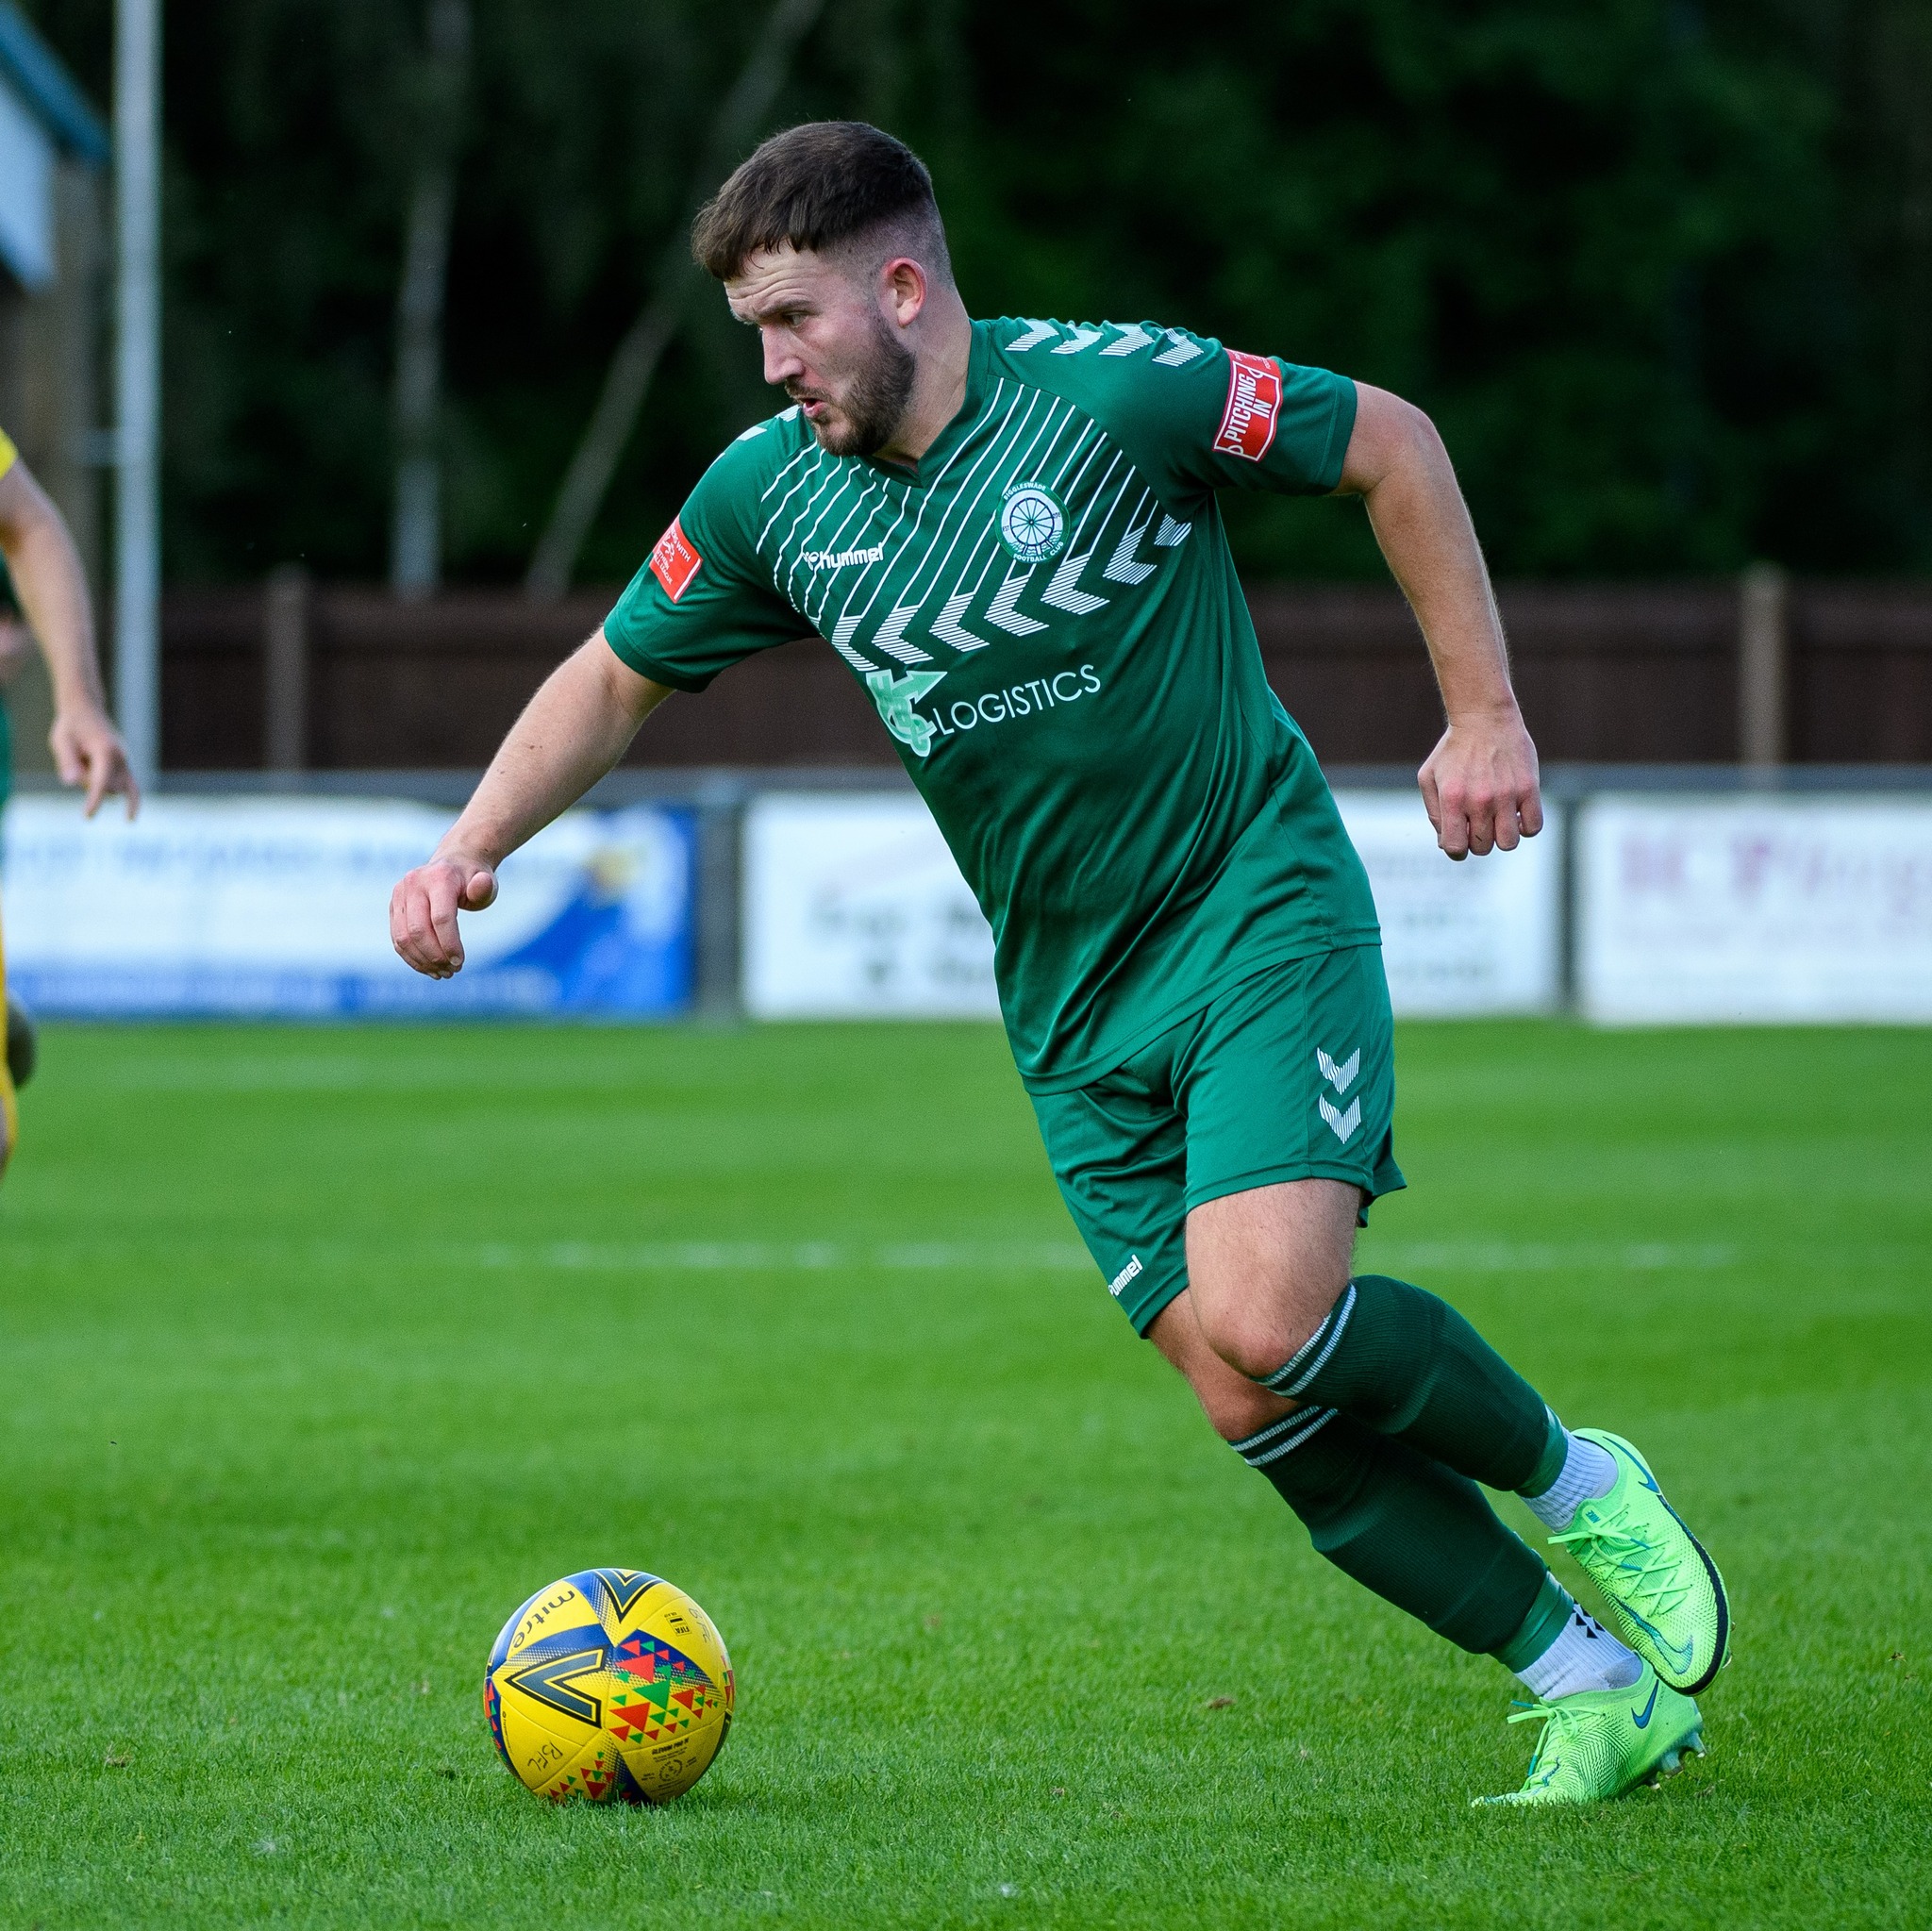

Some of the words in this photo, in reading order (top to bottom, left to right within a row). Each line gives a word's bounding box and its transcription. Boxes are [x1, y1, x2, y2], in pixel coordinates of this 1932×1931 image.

[1224, 373, 1257, 443] PITCHING
[1253, 398, 1273, 419] IN
[1003, 482, 1047, 500] BIGGLESWADE
[676, 541, 691, 562] WITH
[819, 541, 883, 570] hummel
[1013, 553, 1047, 562] FOOTBALL
[1049, 541, 1064, 556] CLUB
[933, 664, 1101, 735] LOGISTICS
[511, 1590, 575, 1649] mitre
[675, 1625, 690, 1634] FIFA
